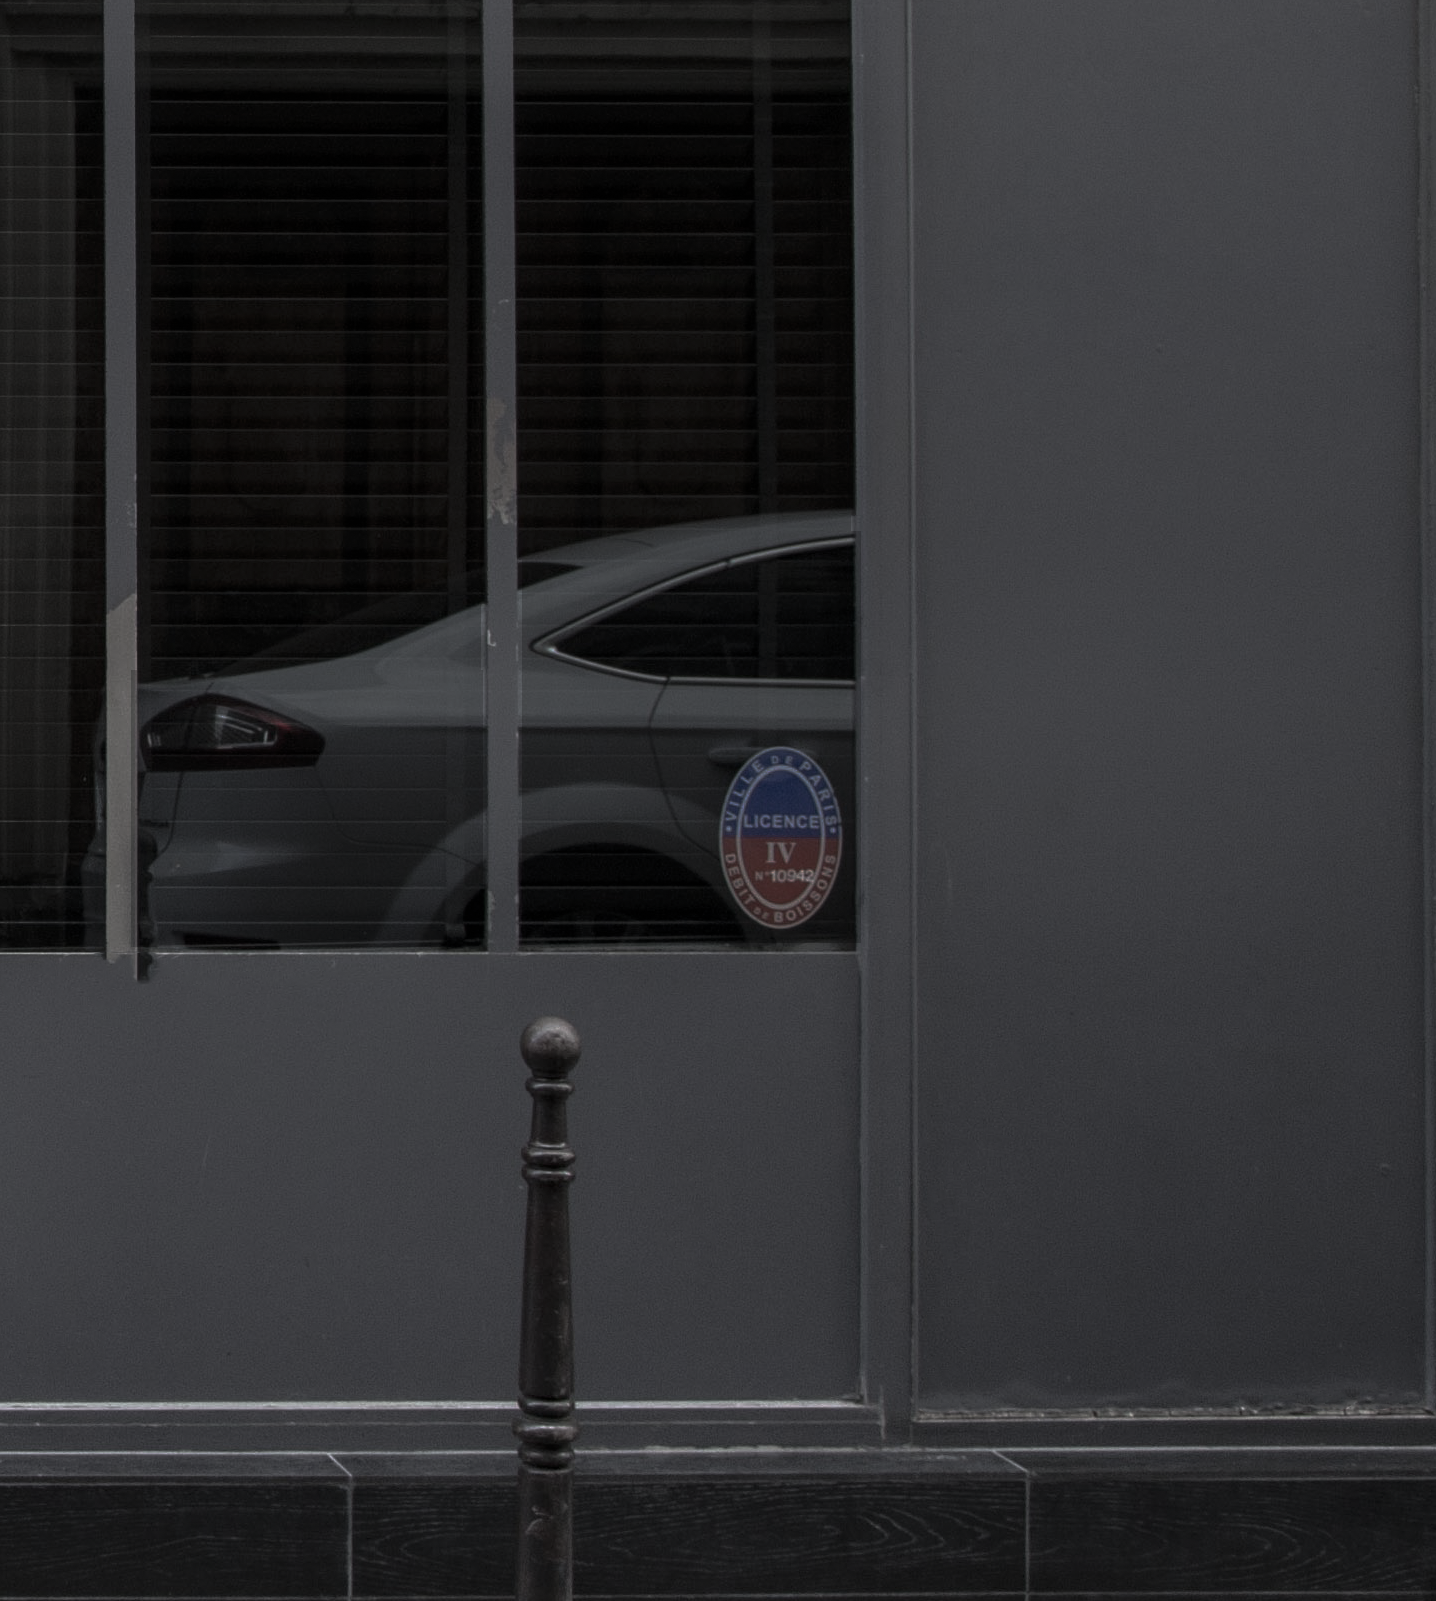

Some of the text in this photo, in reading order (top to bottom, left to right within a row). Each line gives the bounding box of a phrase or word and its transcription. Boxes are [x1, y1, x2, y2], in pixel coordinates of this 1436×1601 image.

[725, 754, 837, 826] VILLE DE PARIS
[744, 814, 820, 829] LICENCE
[765, 841, 797, 864] IV
[725, 853, 836, 923] DEBIT DE BOISSONS
